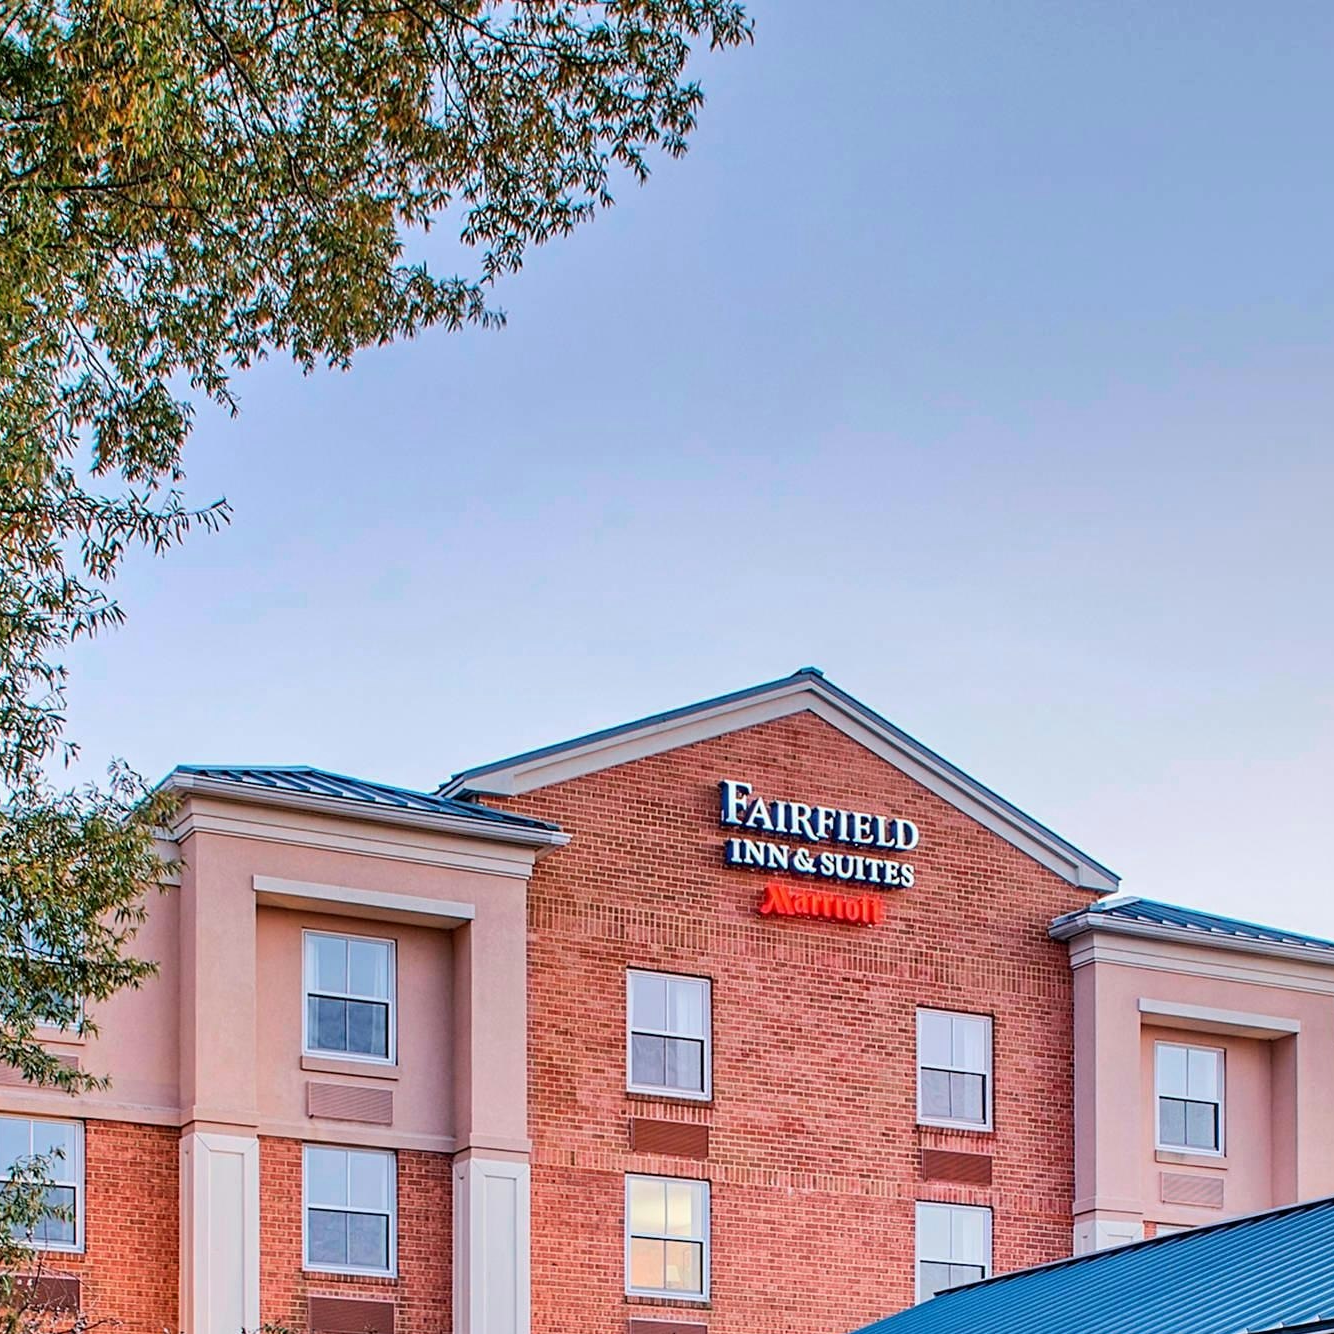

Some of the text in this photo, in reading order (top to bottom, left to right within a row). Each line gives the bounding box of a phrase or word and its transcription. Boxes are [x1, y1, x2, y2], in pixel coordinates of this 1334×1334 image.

[720, 779, 920, 851] FAIRFIELD
[727, 837, 915, 888] INN & SUITES
[760, 881, 883, 924] Marriott
